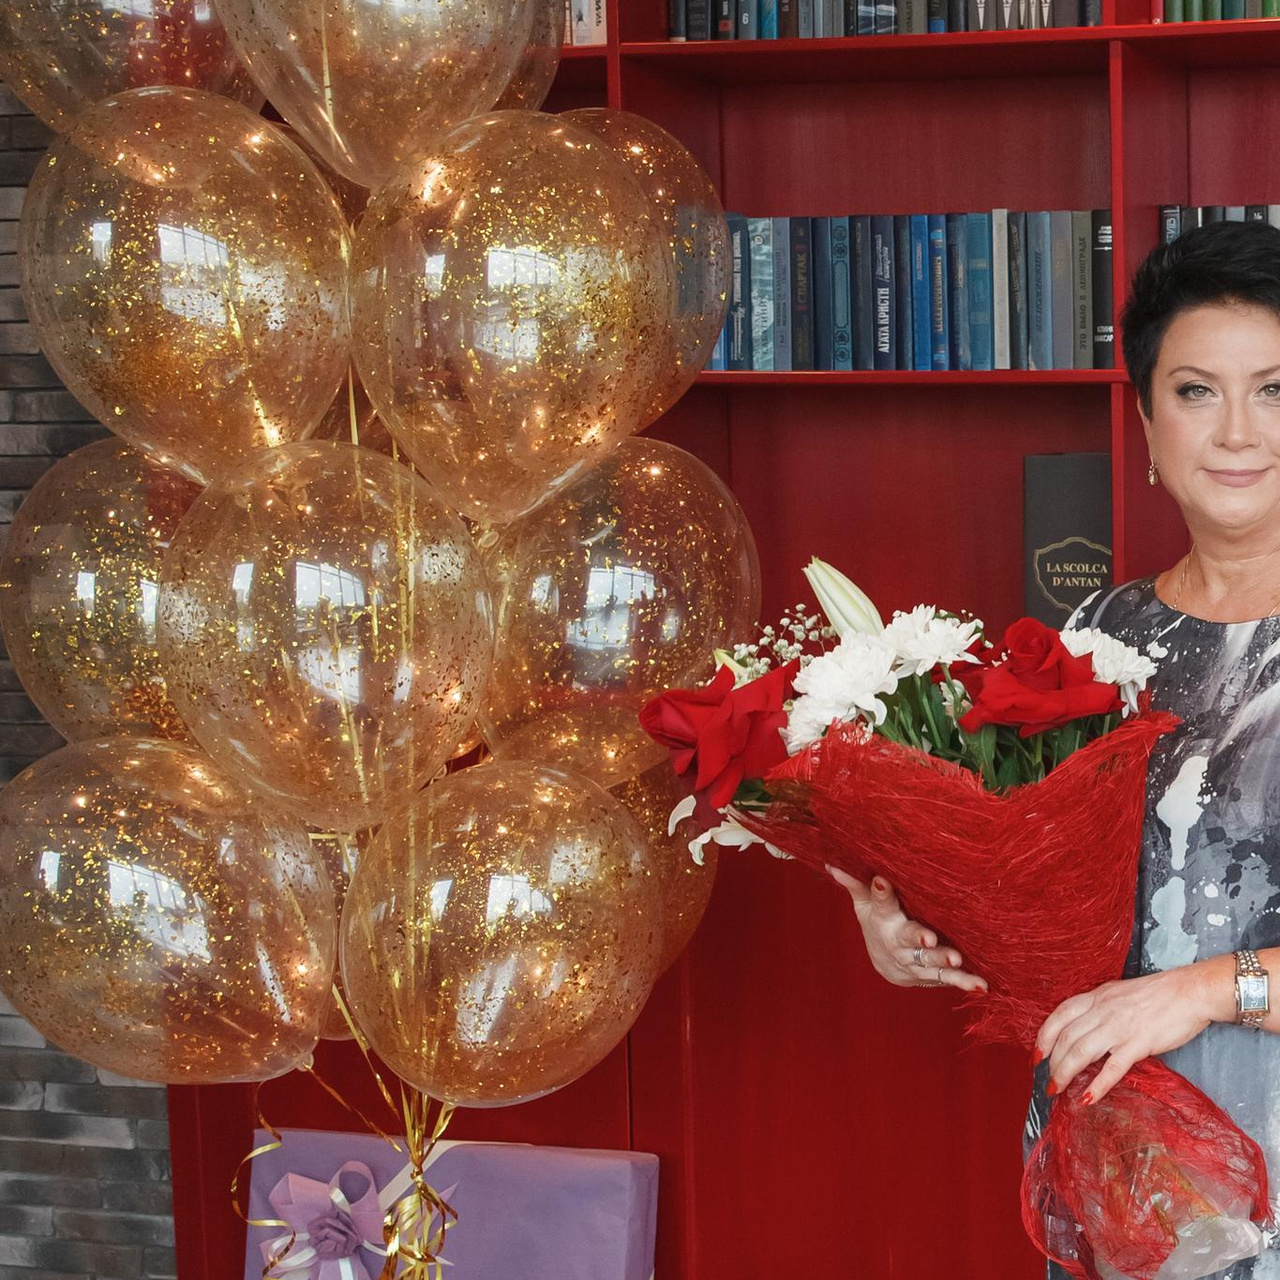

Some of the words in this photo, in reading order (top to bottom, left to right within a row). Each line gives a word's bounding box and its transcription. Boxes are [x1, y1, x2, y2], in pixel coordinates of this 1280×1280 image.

[877, 288, 890, 324] КРИСТИ
[877, 325, 890, 353] АГАТА
[1045, 562, 1061, 573] LA
[1062, 562, 1108, 574] SCOLCA
[1052, 577, 1102, 587] D'ANTAN
